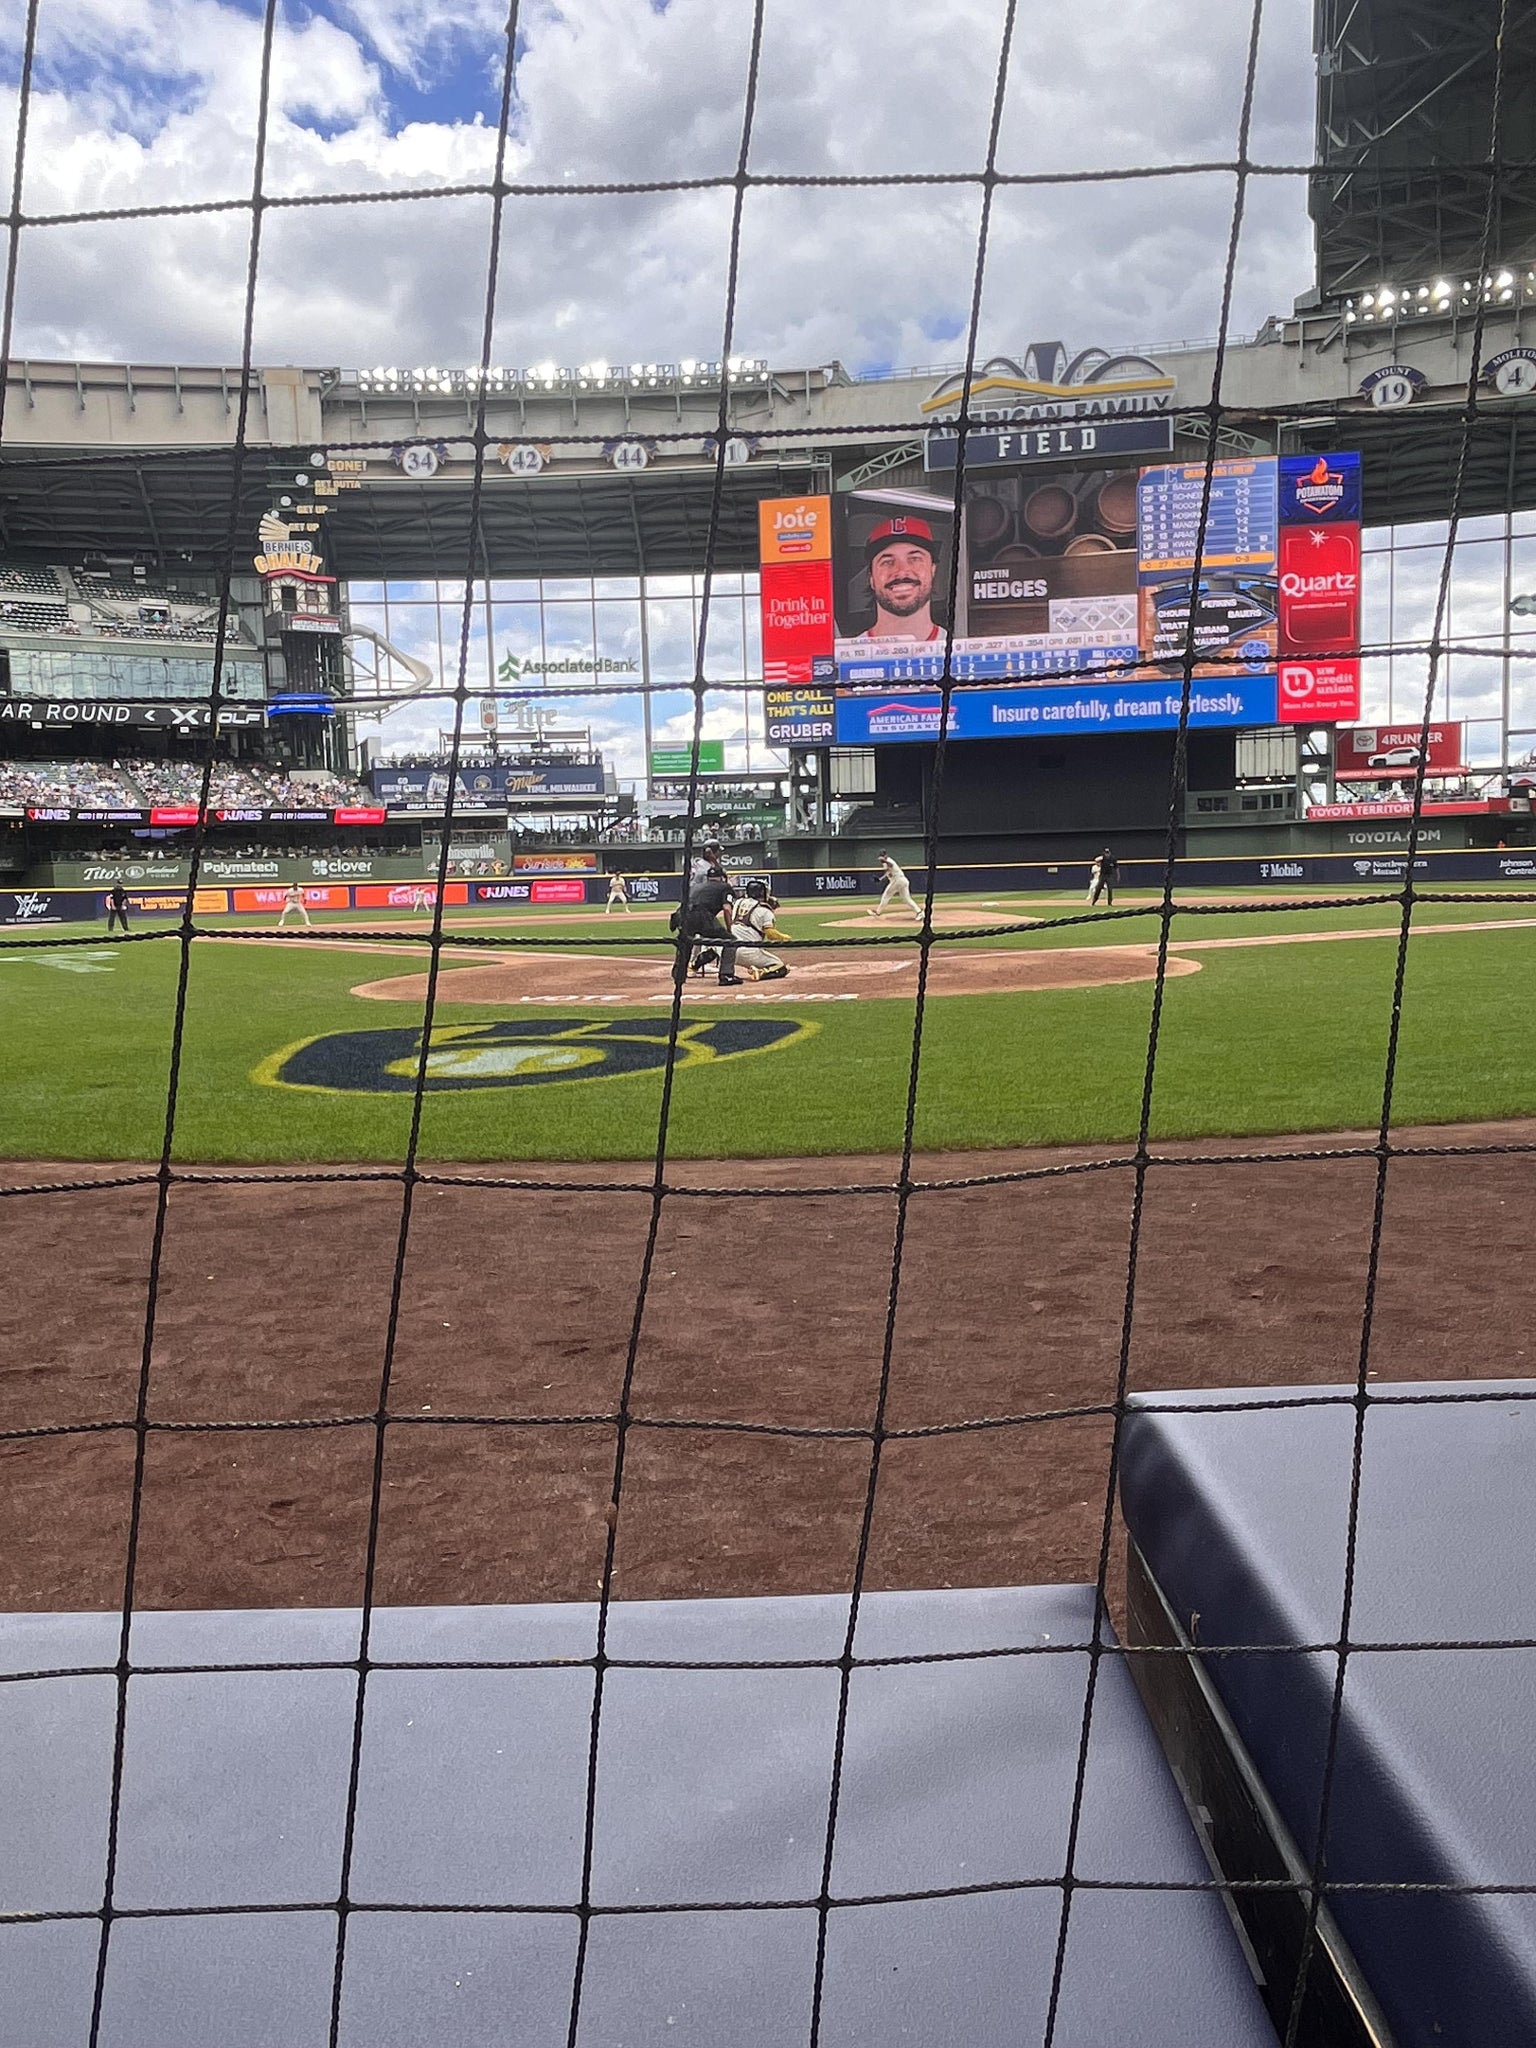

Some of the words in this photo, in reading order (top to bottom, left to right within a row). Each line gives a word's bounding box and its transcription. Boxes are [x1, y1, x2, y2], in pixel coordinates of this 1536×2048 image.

[1492, 349, 1536, 367] MOLITO
[1375, 367, 1412, 379] YOUNT
[1508, 366, 1525, 387] 4
[1379, 382, 1407, 404] 19
[998, 428, 1096, 458] FIELD
[407, 452, 432, 471] 34
[512, 450, 539, 470] 42
[617, 447, 642, 467] 44
[773, 506, 817, 529] Joie
[264, 541, 312, 553] BERNIE'S
[254, 552, 323, 574] CHALET
[973, 568, 1010, 580] AUSTIN
[973, 579, 1048, 600] HEDGES
[1280, 572, 1356, 598] Quartz
[770, 596, 809, 612] Drink
[812, 596, 825, 610] in
[766, 611, 830, 630] Together
[969, 663, 974, 673] 2
[1070, 657, 1076, 667] 2
[1316, 673, 1353, 684] credit
[1316, 683, 1354, 694] union
[767, 691, 792, 703] ONE
[46, 704, 131, 722] ROUND
[171, 709, 199, 725] X
[767, 704, 809, 717] THAT'S
[811, 703, 834, 715] ALL!
[992, 704, 1039, 723] Insure
[1042, 701, 1111, 722] carefully,
[1114, 697, 1161, 717] dream
[1165, 692, 1244, 716] ferlessly.
[517, 705, 558, 731] Lite
[870, 713, 919, 725] AMERICAN
[769, 722, 832, 738] GRUBER
[505, 774, 547, 793] Miller
[733, 802, 757, 810] ALLEY
[1310, 805, 1353, 818] TOYOTA
[34, 809, 70, 821] KUNES
[223, 809, 263, 821] KUNES
[328, 859, 372, 873] clover
[720, 854, 753, 866] Save
[1499, 859, 1533, 868] Johnson
[83, 866, 124, 880] Tito's
[203, 861, 278, 876] Polymatech
[1270, 863, 1303, 877] Mobile
[1373, 867, 1401, 875] Mutual
[630, 881, 658, 894] TRUSS
[826, 877, 856, 890] Mobile
[486, 886, 529, 899] KUNES
